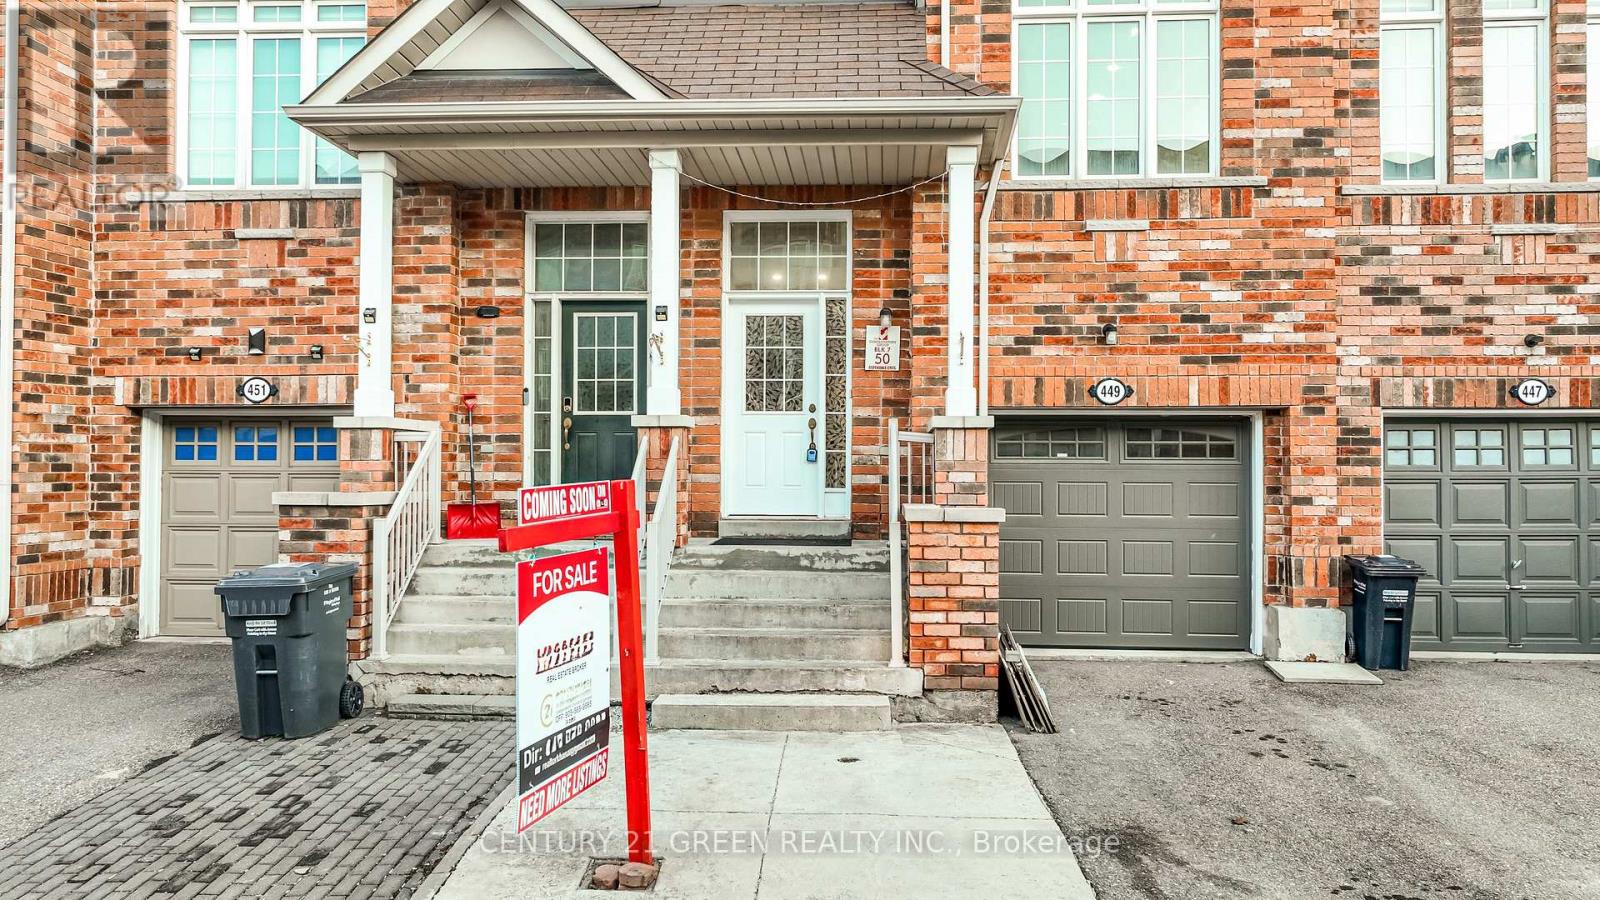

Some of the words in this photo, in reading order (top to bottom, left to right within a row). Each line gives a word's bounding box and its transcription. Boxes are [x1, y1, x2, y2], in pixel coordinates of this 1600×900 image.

[874, 352, 890, 365] 50
[247, 384, 266, 396] 451
[1100, 384, 1121, 398] 449
[1522, 384, 1542, 398] 447
[523, 488, 568, 521] COMING
[569, 485, 596, 514] SOON
[532, 568, 563, 598] FOR
[564, 560, 598, 590] SALE
[557, 667, 572, 680] ESTATE
[523, 746, 543, 769] Dir:
[520, 788, 546, 830] NEED
[545, 771, 572, 813] MORE
[571, 751, 607, 796] LISTINGS
